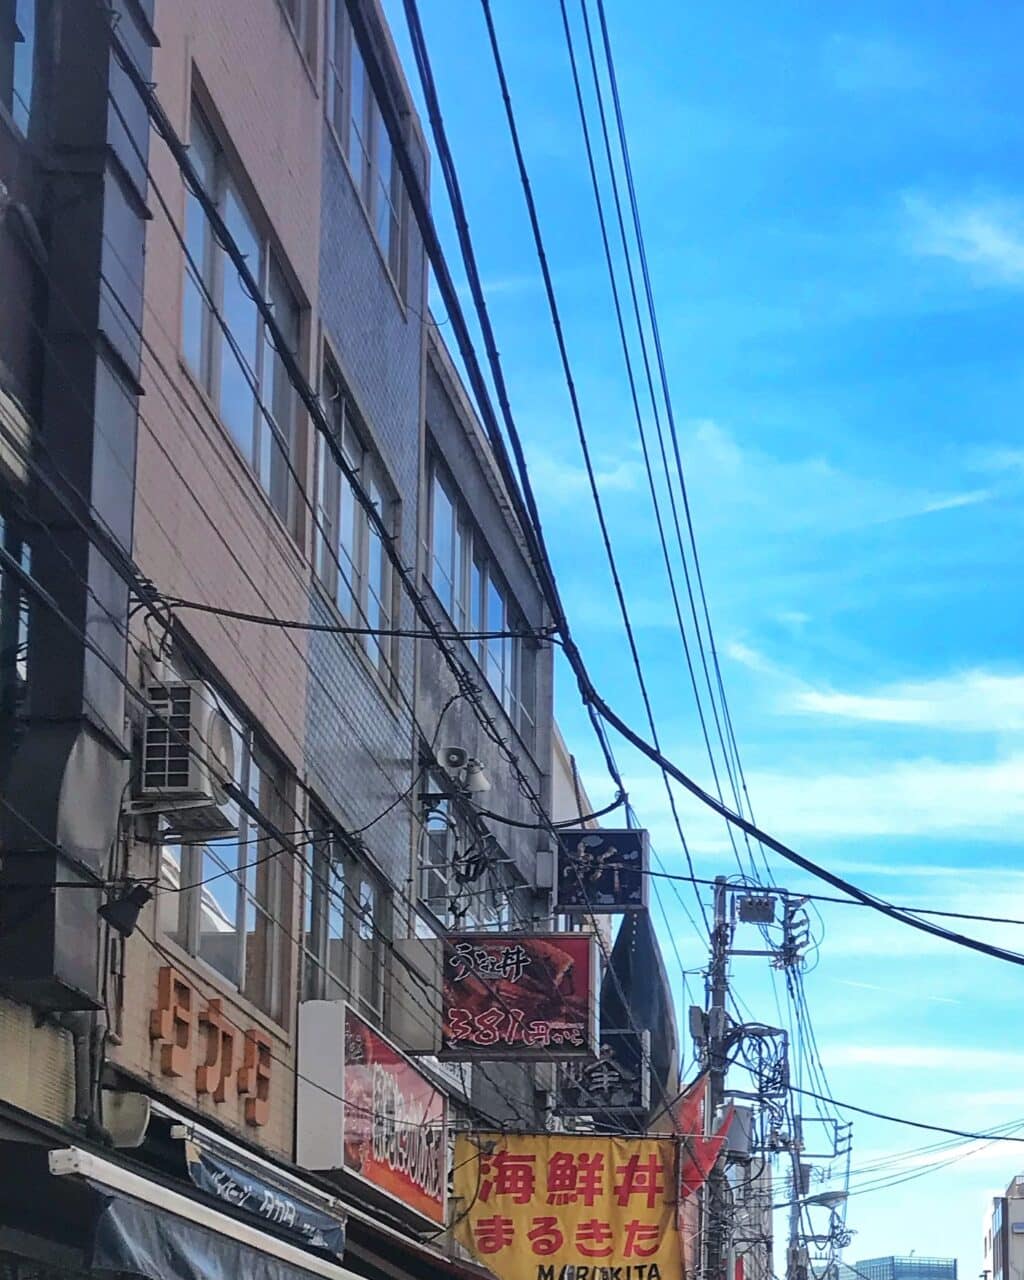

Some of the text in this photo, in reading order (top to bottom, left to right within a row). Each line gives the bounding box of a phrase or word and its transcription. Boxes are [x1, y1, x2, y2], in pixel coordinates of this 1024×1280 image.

[479, 1150, 664, 1209] 海鮮丼
[474, 1215, 662, 1258] まるきた
